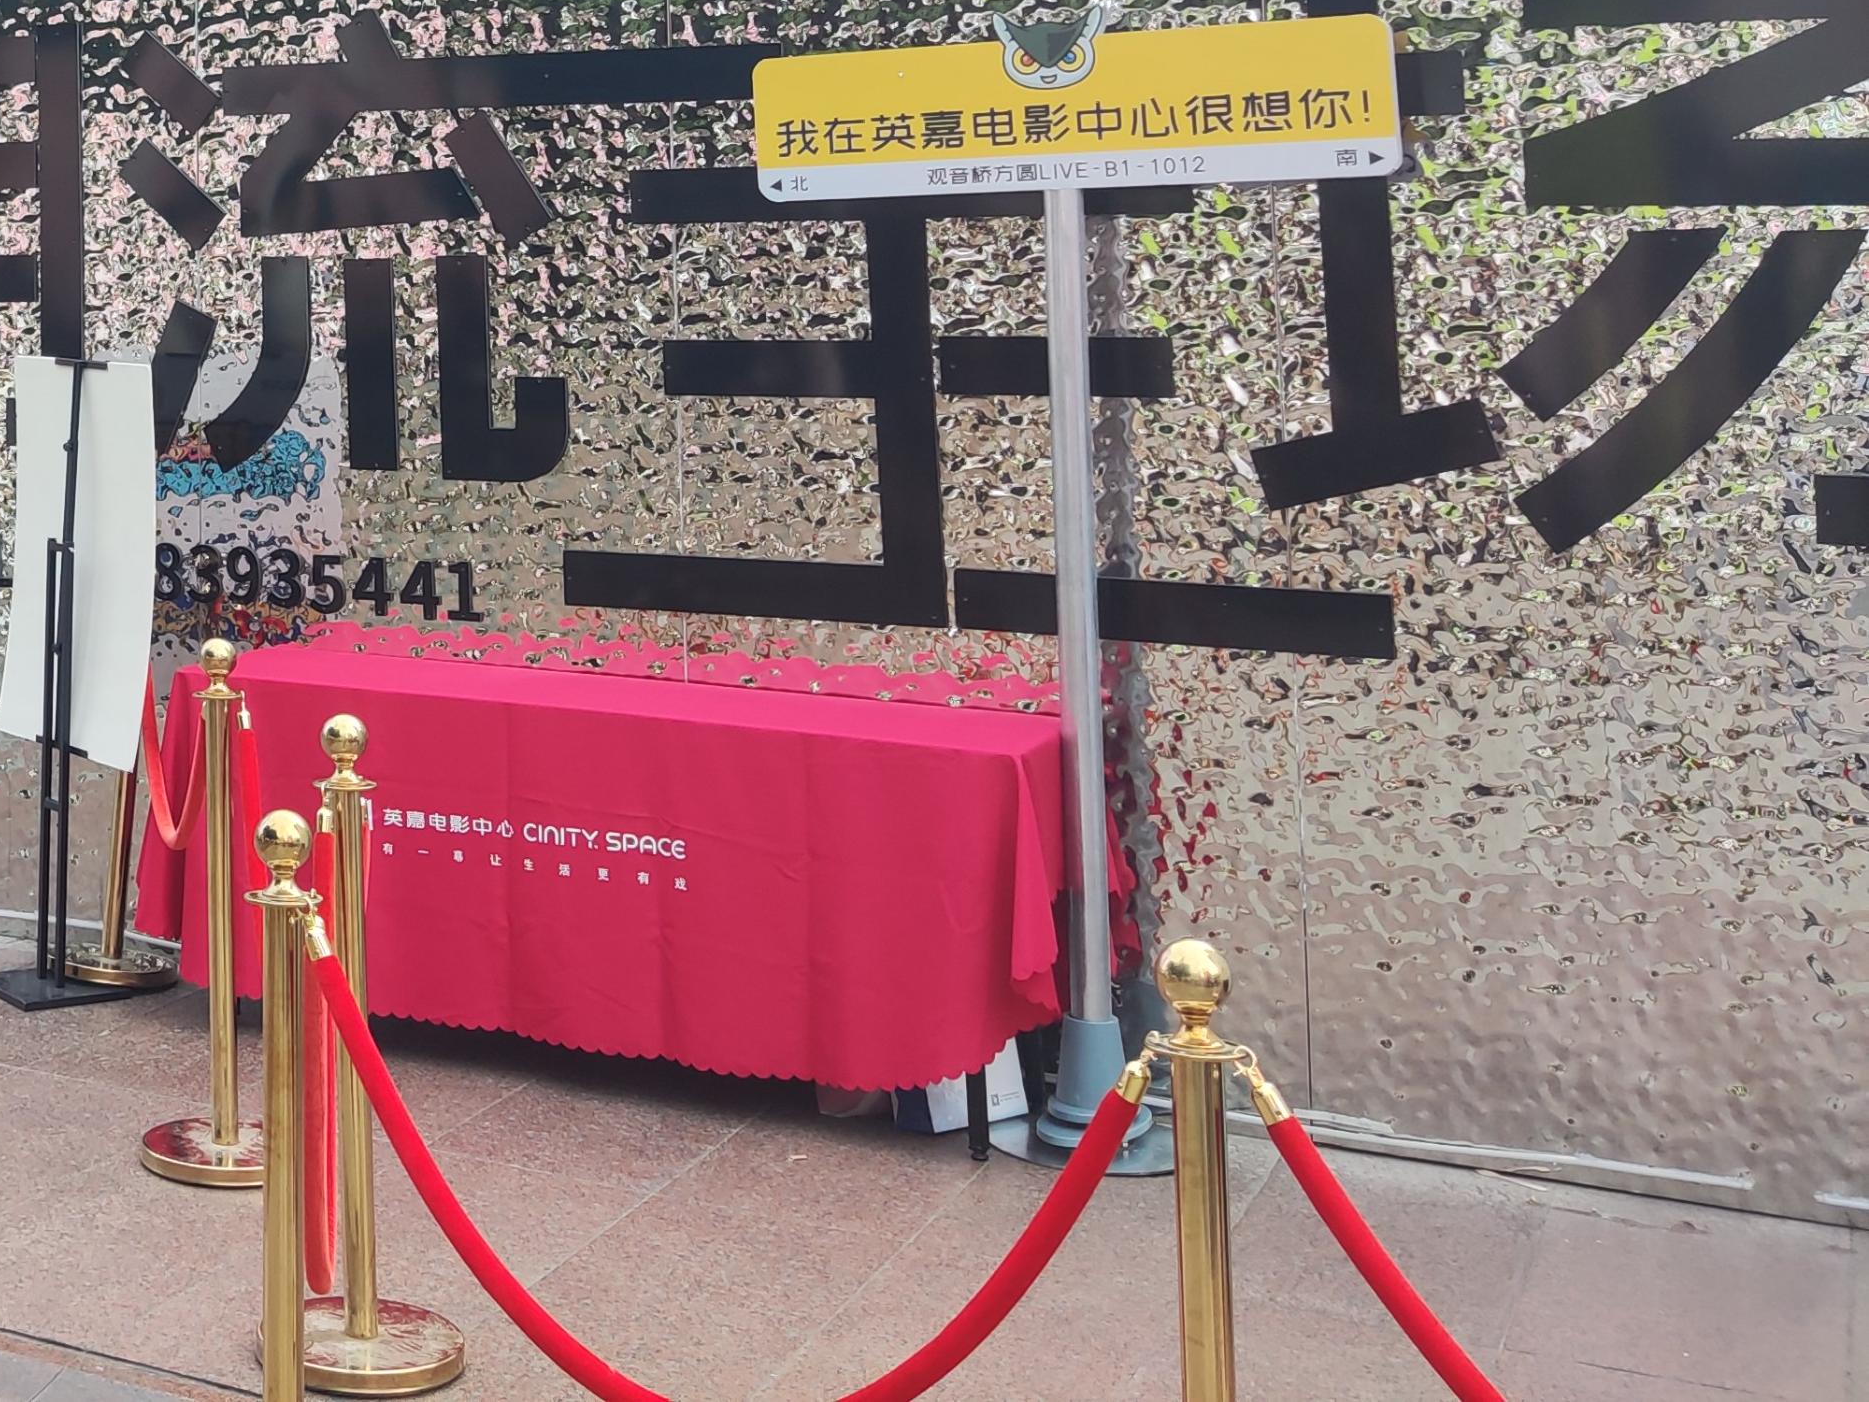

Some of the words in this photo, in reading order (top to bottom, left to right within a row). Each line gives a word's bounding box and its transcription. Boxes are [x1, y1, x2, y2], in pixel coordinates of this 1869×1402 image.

[1334, 149, 1358, 167] 南
[789, 174, 809, 193] 北
[382, 807, 515, 838] 英嘉电影中心
[605, 831, 687, 860] SPACE
